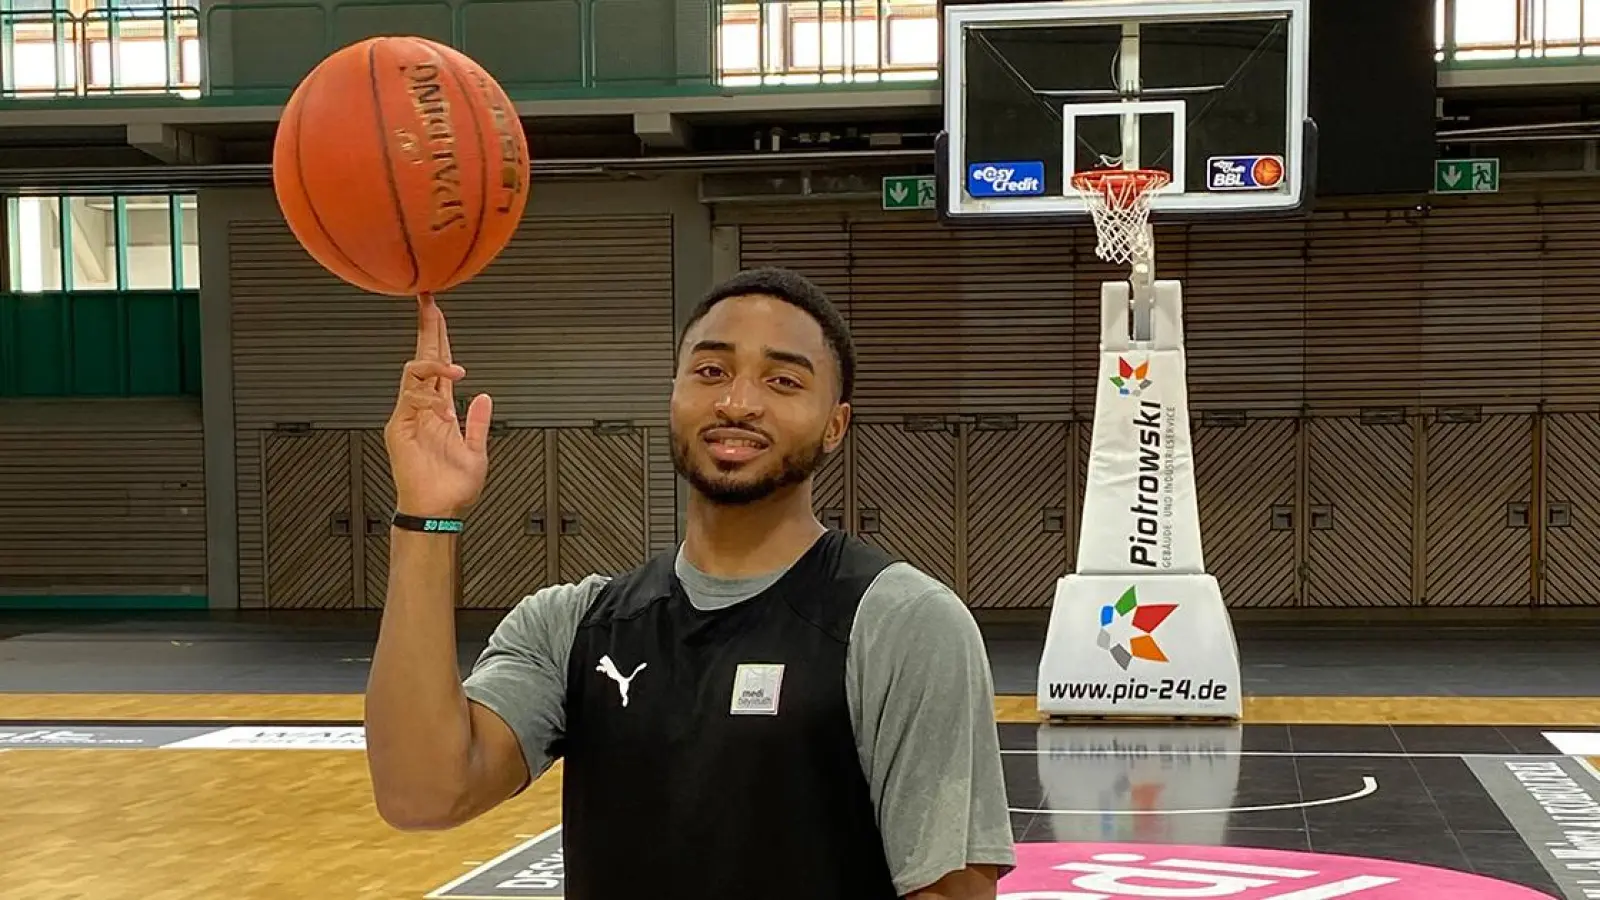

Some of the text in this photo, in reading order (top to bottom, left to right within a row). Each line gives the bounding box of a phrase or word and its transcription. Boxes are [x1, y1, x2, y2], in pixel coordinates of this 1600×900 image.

[411, 63, 465, 232] SPALDING
[992, 177, 1039, 192] Credit
[1213, 173, 1245, 186] BBL
[1129, 400, 1161, 568] Piotrowski
[1163, 496, 1173, 517] UND
[1049, 679, 1227, 704] www.pio-24.de
